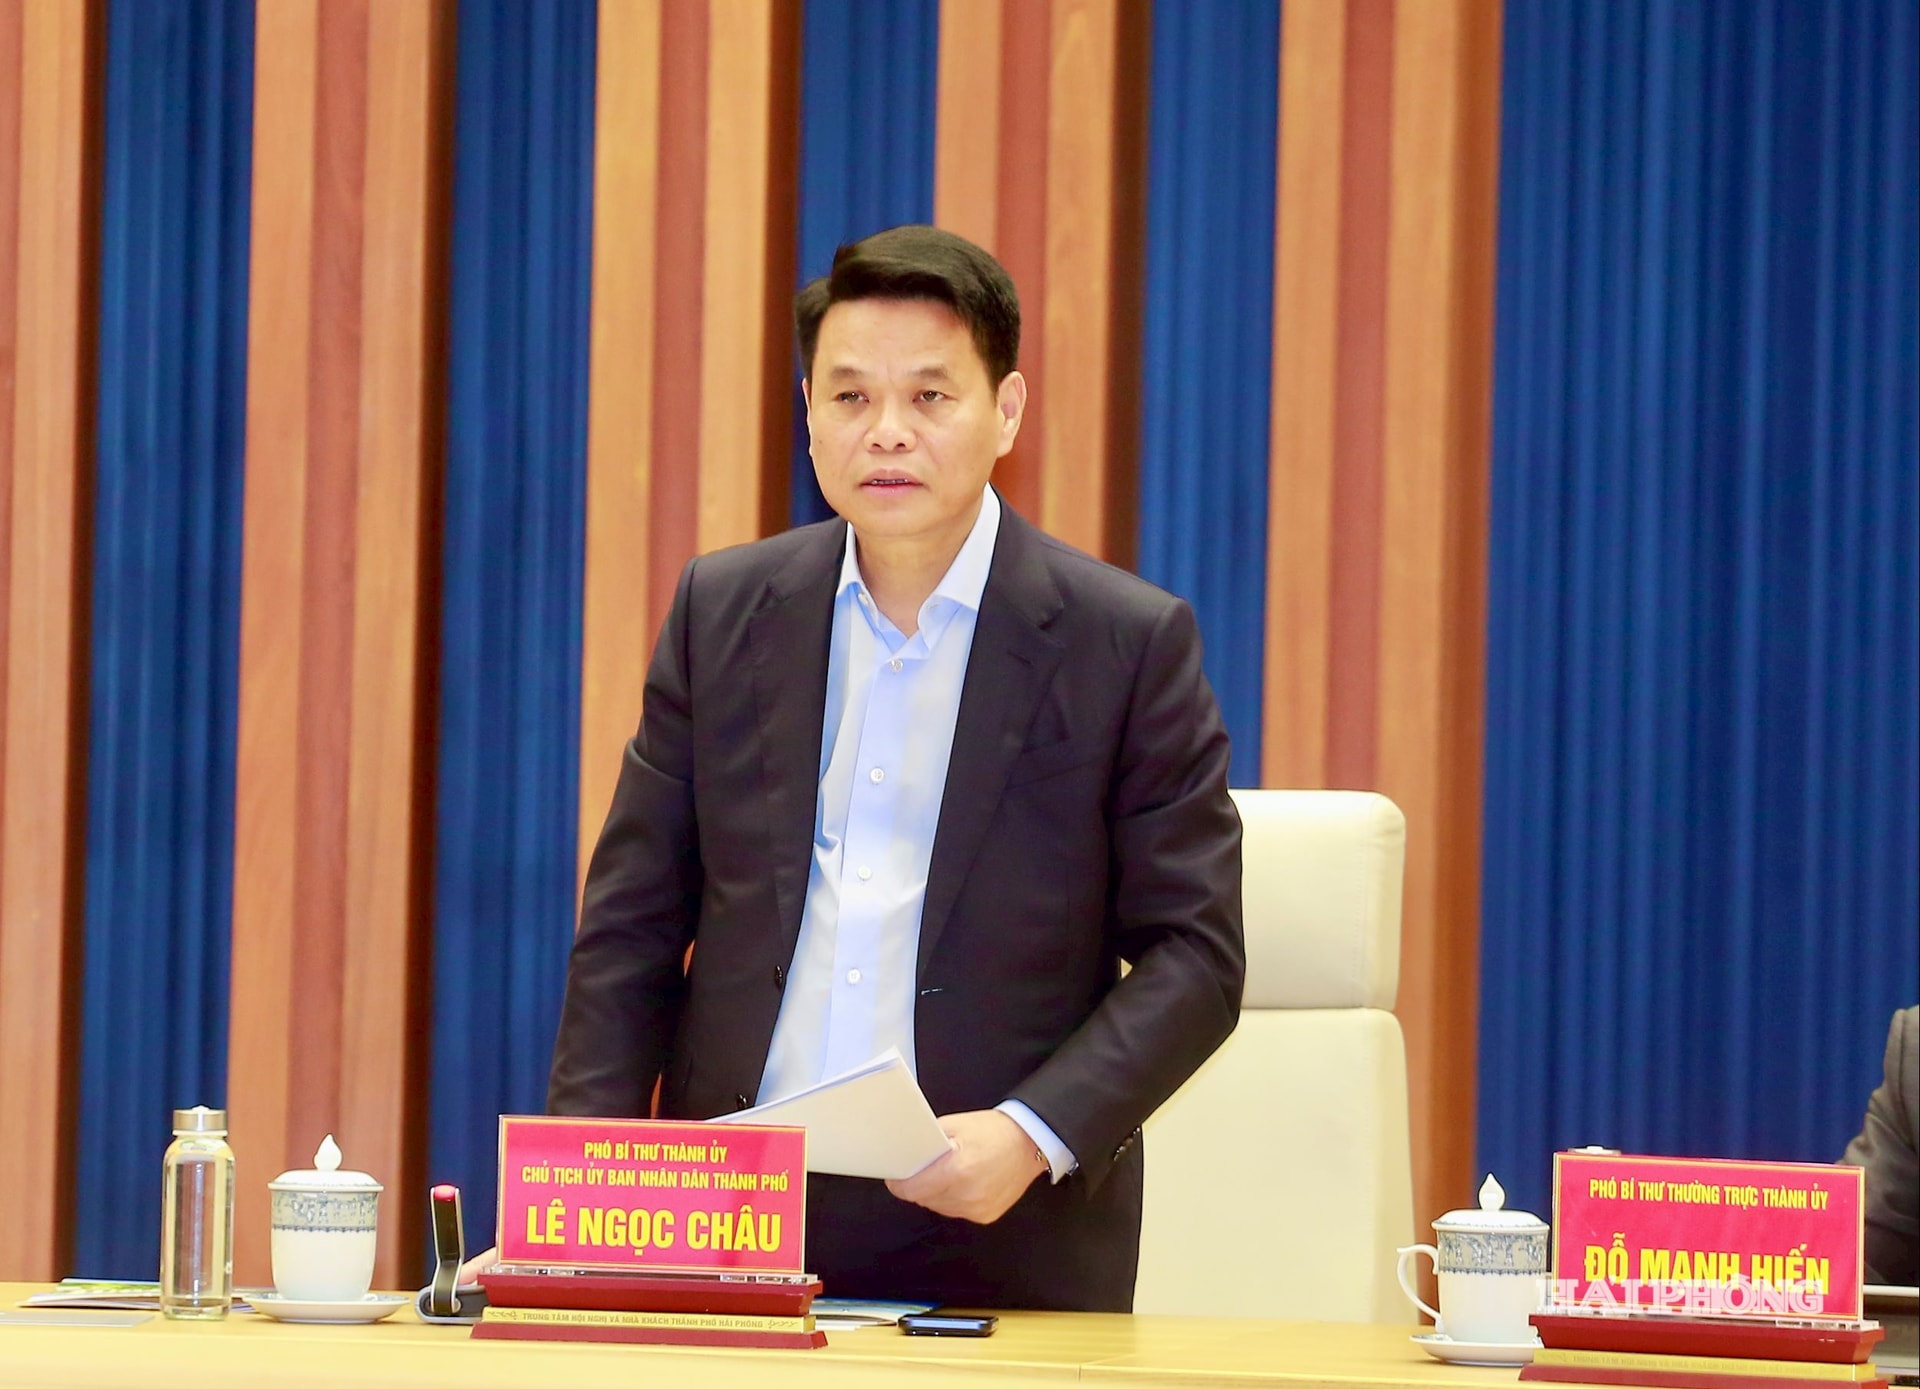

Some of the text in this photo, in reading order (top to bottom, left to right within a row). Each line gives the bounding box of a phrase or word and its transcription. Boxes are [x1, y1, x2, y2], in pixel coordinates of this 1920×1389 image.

[584, 1139, 727, 1164] PHÓ BÍ THƯ THÀNH ỦY
[522, 1160, 789, 1192] CHỦ TỊCH ỦY BAN NHÂN DÂN THÀNH PHỐ
[1589, 1176, 1829, 1210] PHÓ BÍ THƯ THƯỜNG TRỰC THÀNH ỦY
[526, 1198, 782, 1256] LÊ NGỌC CHÂU
[1584, 1232, 1629, 1284] ĐỖ
[522, 1312, 550, 1321] TRUNG
